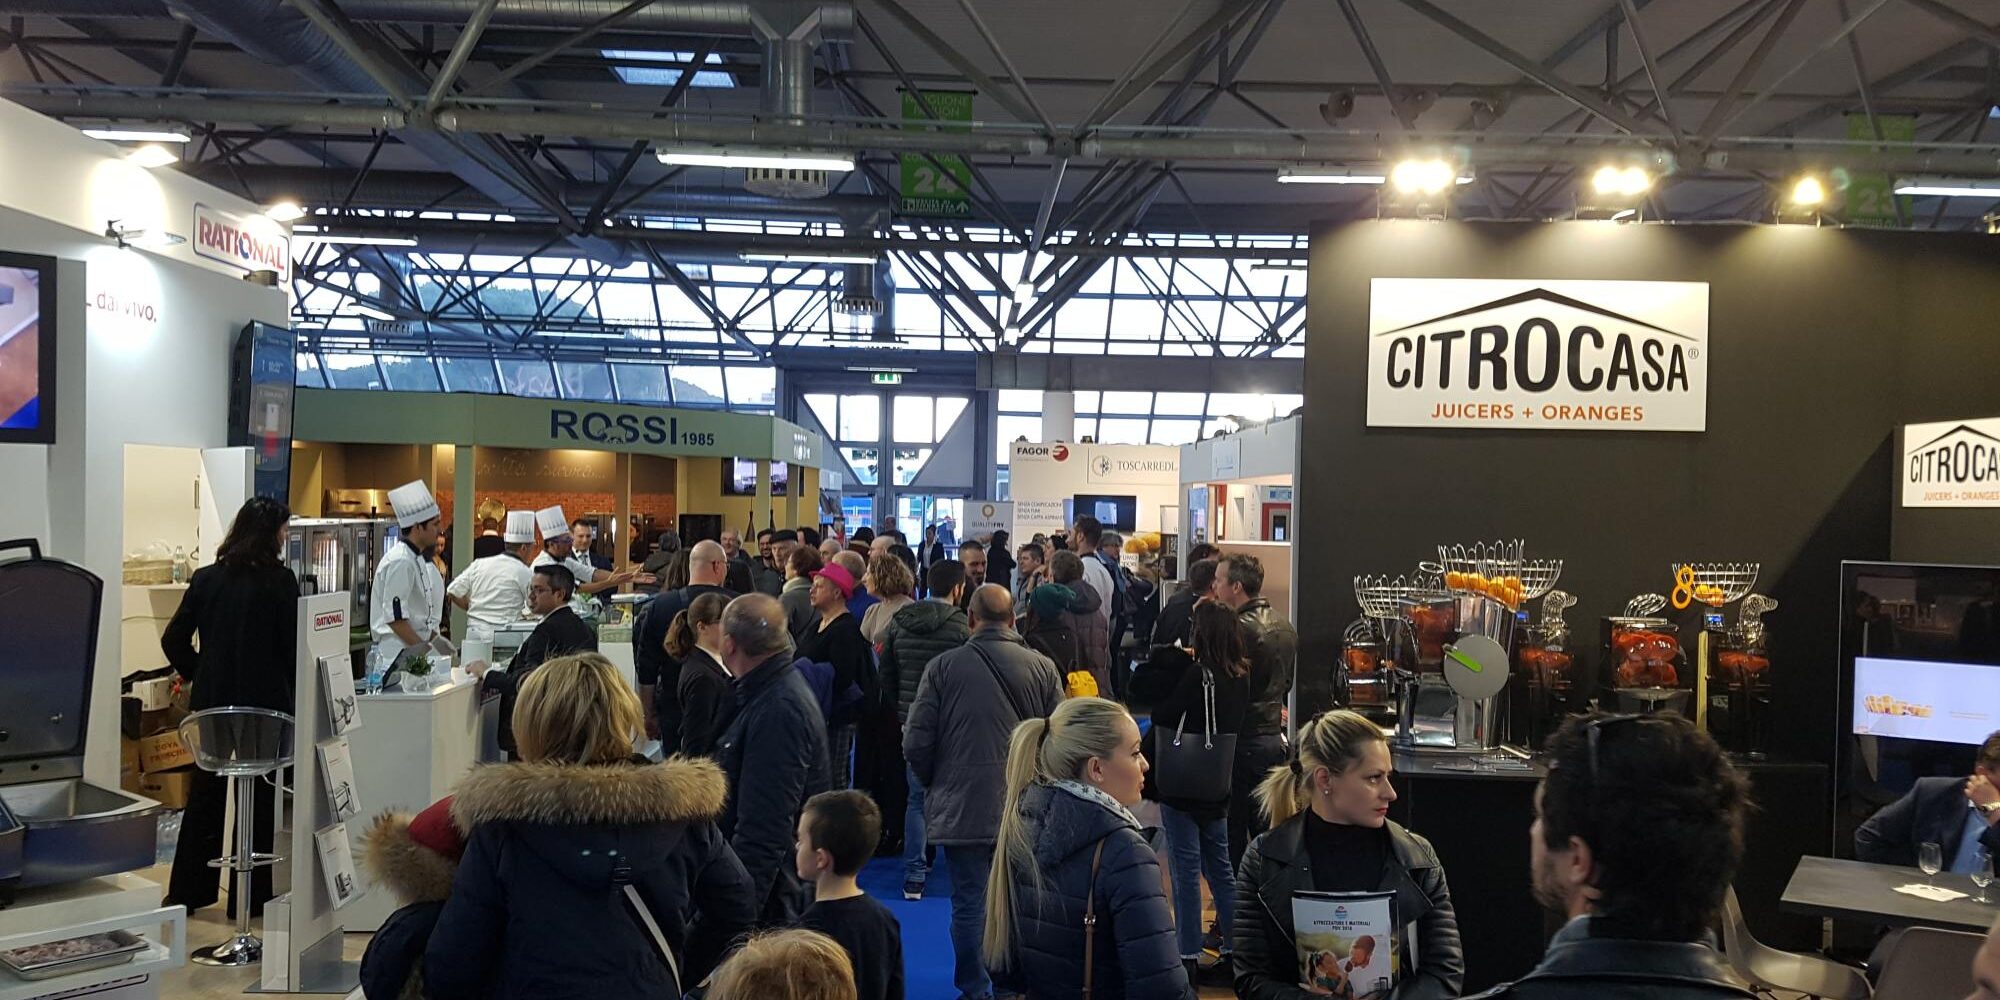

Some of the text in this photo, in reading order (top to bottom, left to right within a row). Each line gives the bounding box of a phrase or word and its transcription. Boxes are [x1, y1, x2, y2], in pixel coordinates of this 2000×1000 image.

[199, 215, 285, 271] RATIONAL
[1431, 403, 1514, 420] JUICERS
[1541, 404, 1644, 422] ORANGES
[550, 408, 715, 446] ROSSI 1985
[1016, 447, 1049, 456] FAGOR
[1910, 440, 2000, 483] CITROCA
[1923, 491, 1953, 501] JUICERS
[316, 613, 342, 627] RATIONAL
